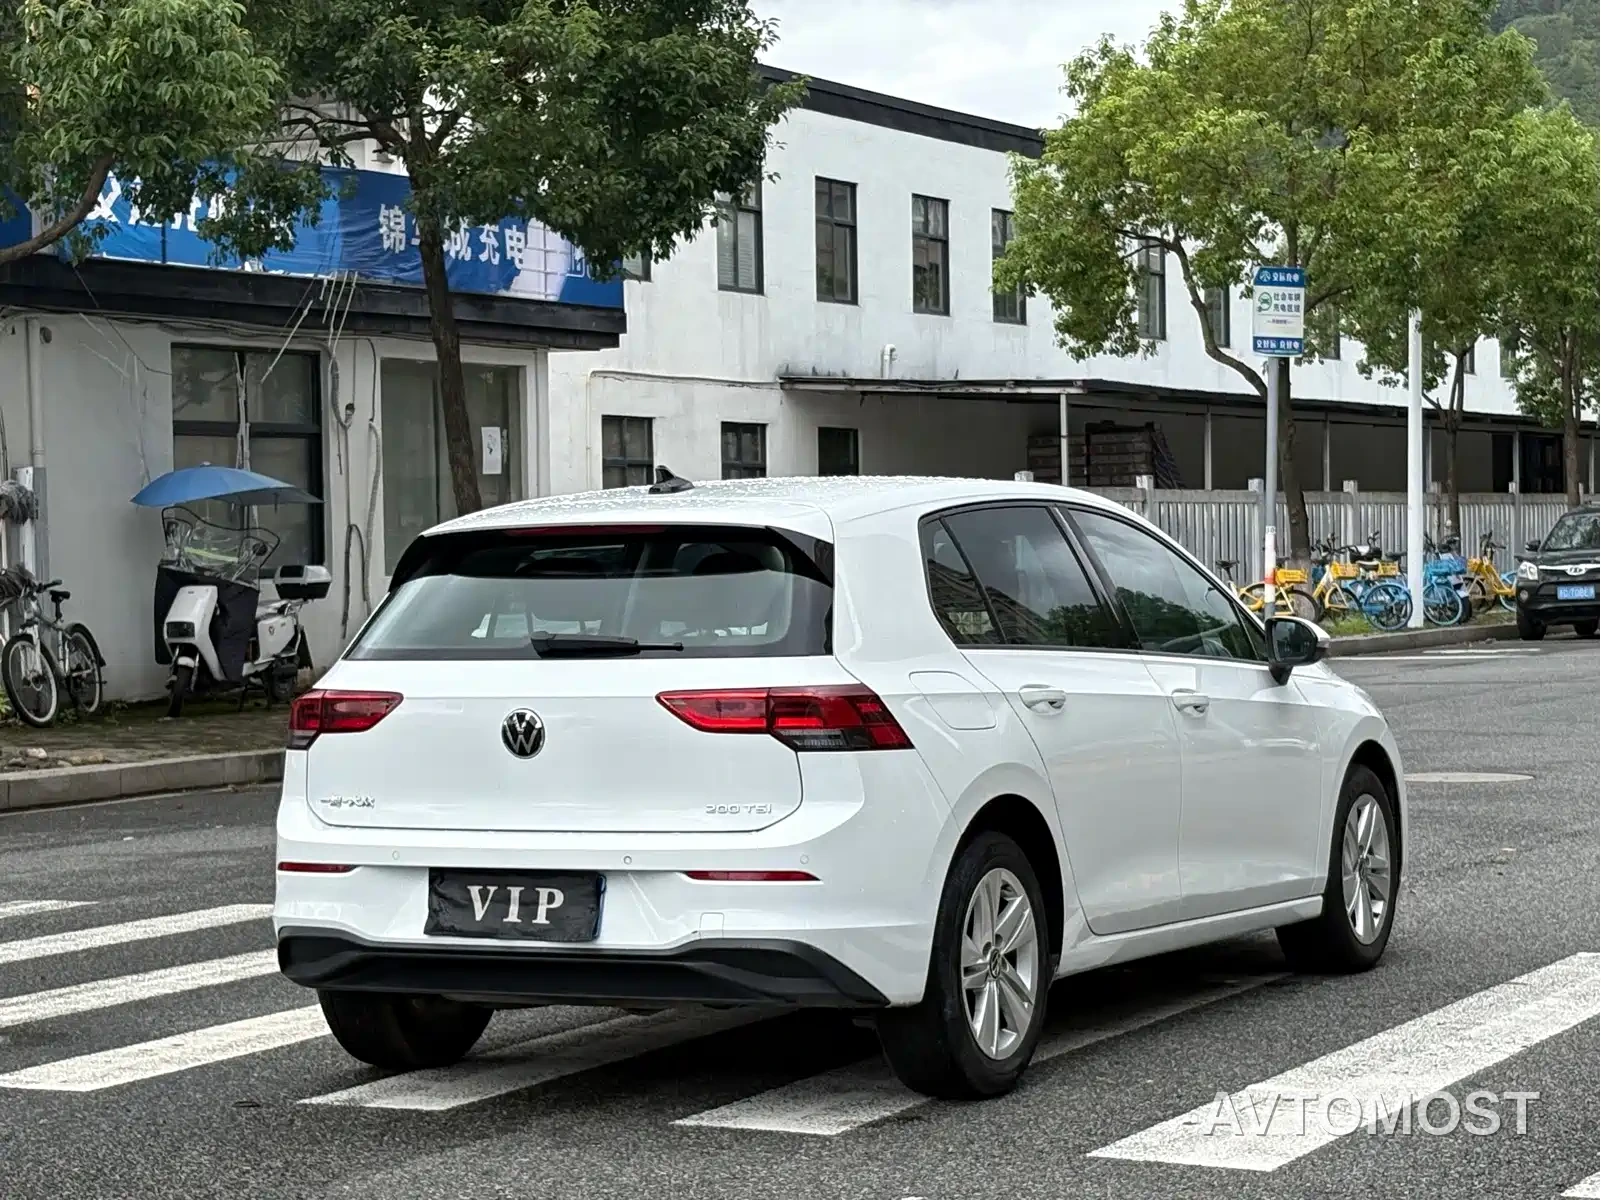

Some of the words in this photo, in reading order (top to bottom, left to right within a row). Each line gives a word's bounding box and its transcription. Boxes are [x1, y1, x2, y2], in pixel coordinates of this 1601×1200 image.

[378, 203, 527, 270] 锦城充电
[1273, 292, 1301, 302] 社会车辆
[1273, 303, 1301, 313] 充电区域
[705, 803, 741, 815] 200
[466, 884, 565, 925] VIP
